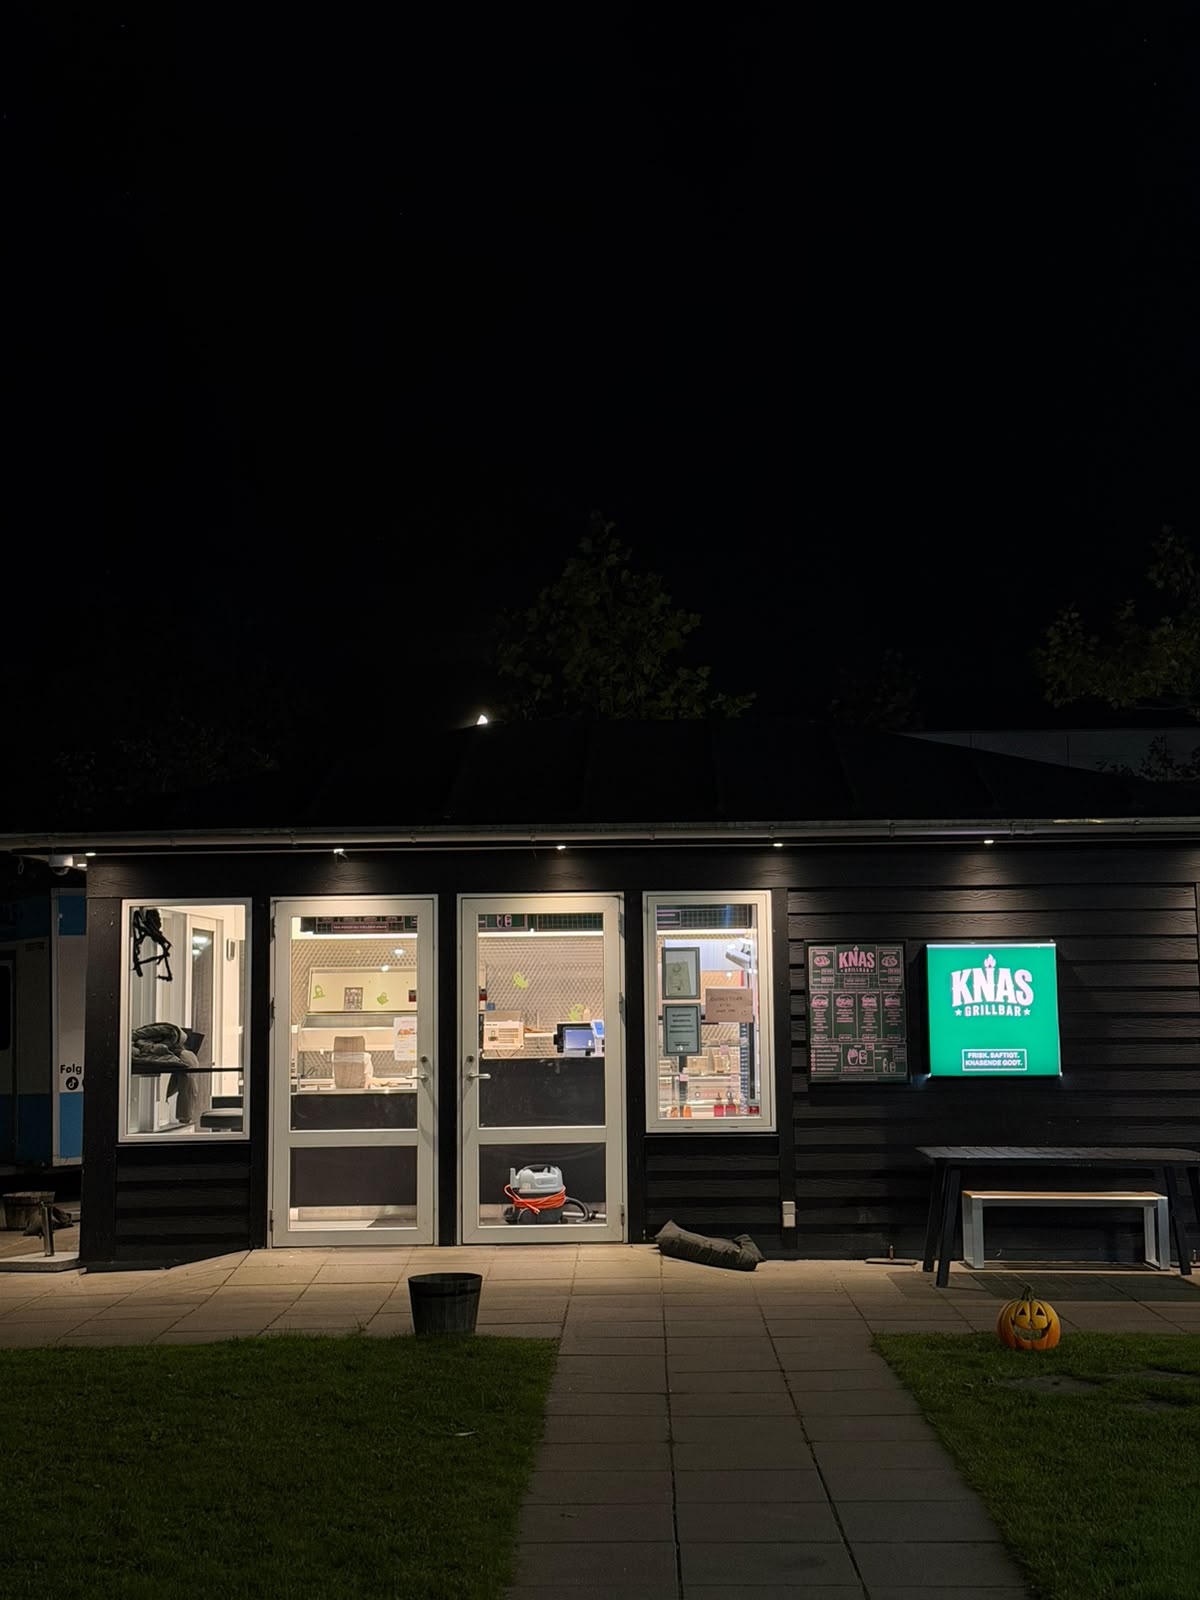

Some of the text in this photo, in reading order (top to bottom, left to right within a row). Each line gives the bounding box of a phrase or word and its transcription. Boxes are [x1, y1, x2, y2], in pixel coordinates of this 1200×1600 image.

[839, 951, 875, 968] KNAS
[951, 967, 1034, 1006] KNAS
[964, 1005, 1021, 1016] GRILLBAR
